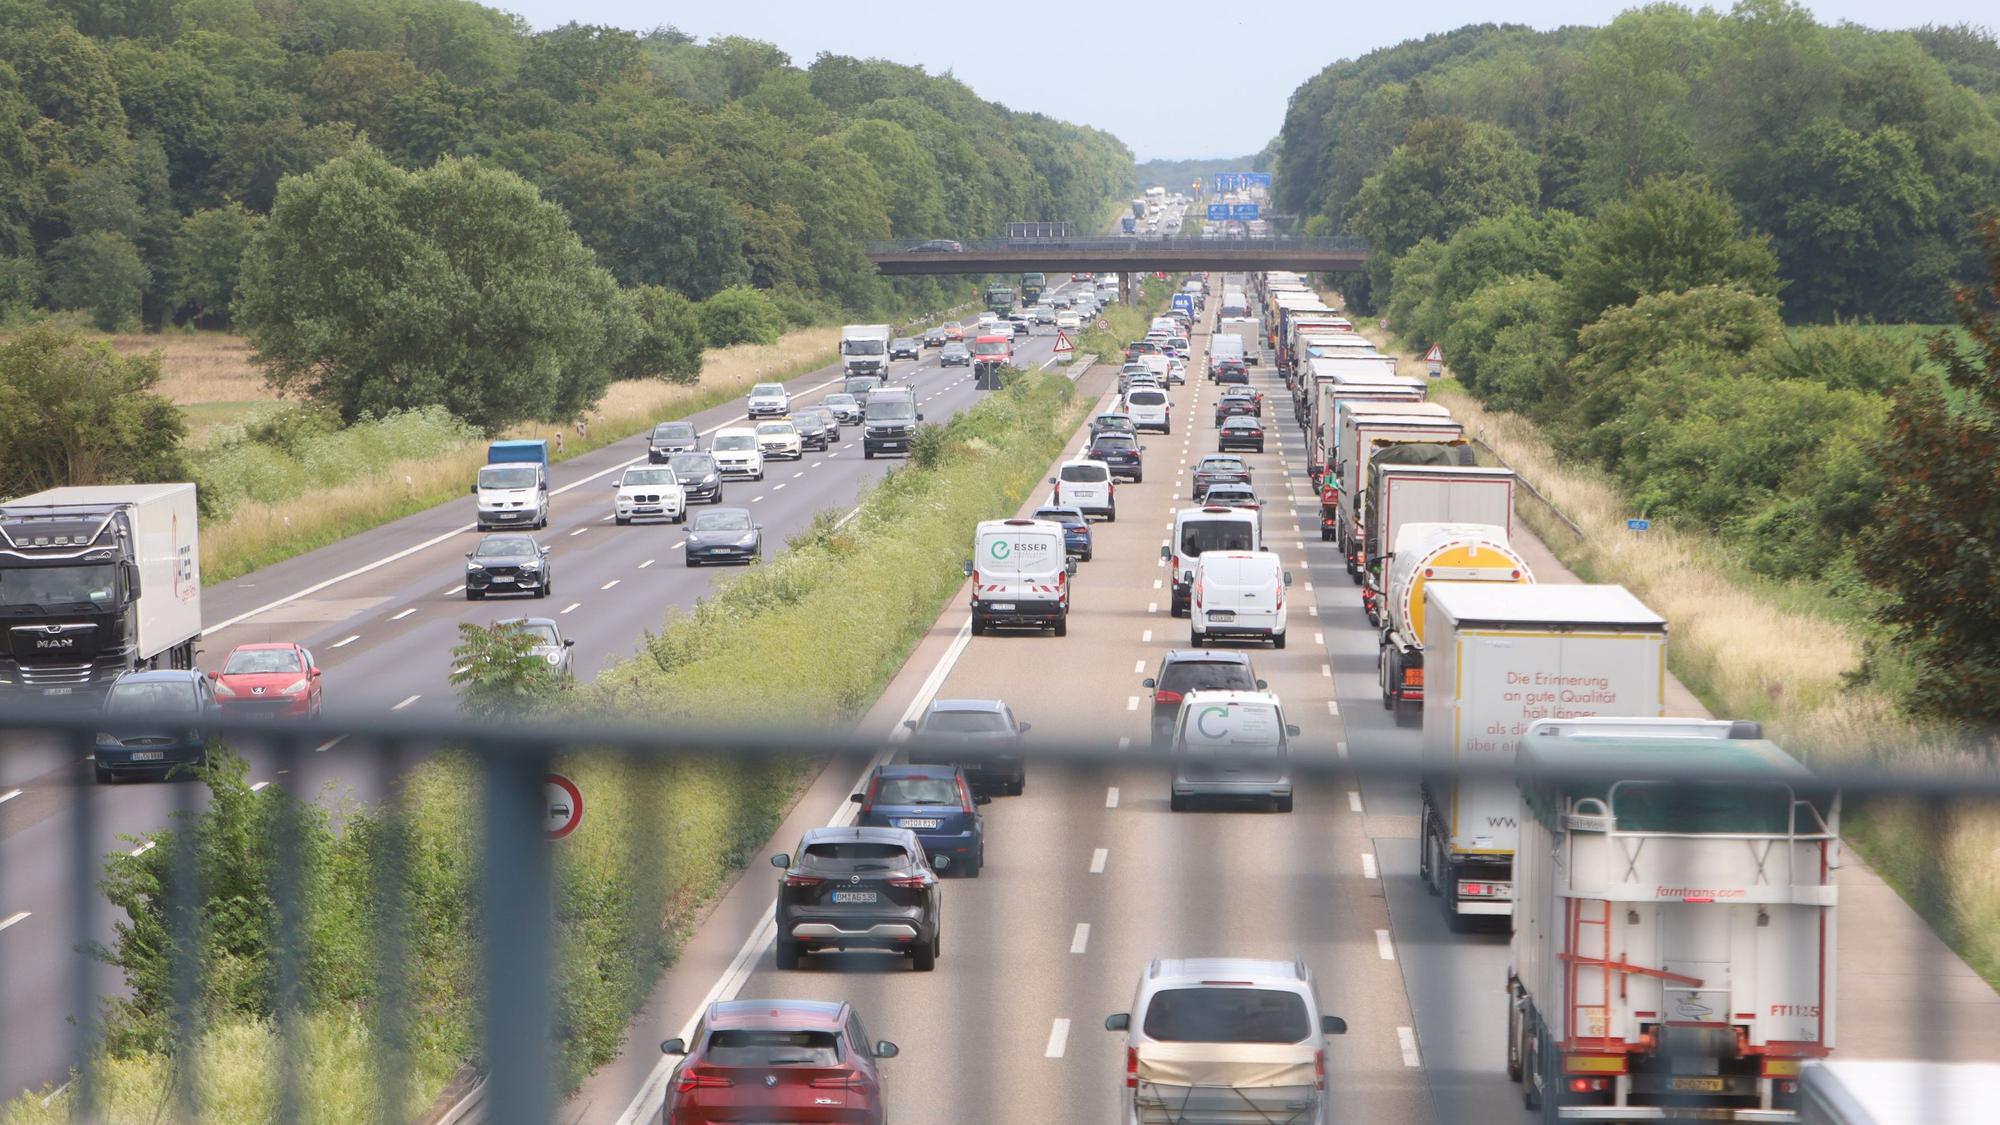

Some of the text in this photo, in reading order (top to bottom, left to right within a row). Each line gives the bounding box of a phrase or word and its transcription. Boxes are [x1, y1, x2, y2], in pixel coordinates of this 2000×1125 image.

[1014, 543, 1048, 551] ESSER
[37, 639, 73, 648] MAN
[1507, 671, 1608, 690] Die Erinnerung
[1503, 690, 1616, 705] an gute Qualität
[1523, 705, 1548, 718] hält
[1487, 721, 1506, 735] als
[1466, 737, 1496, 752] über
